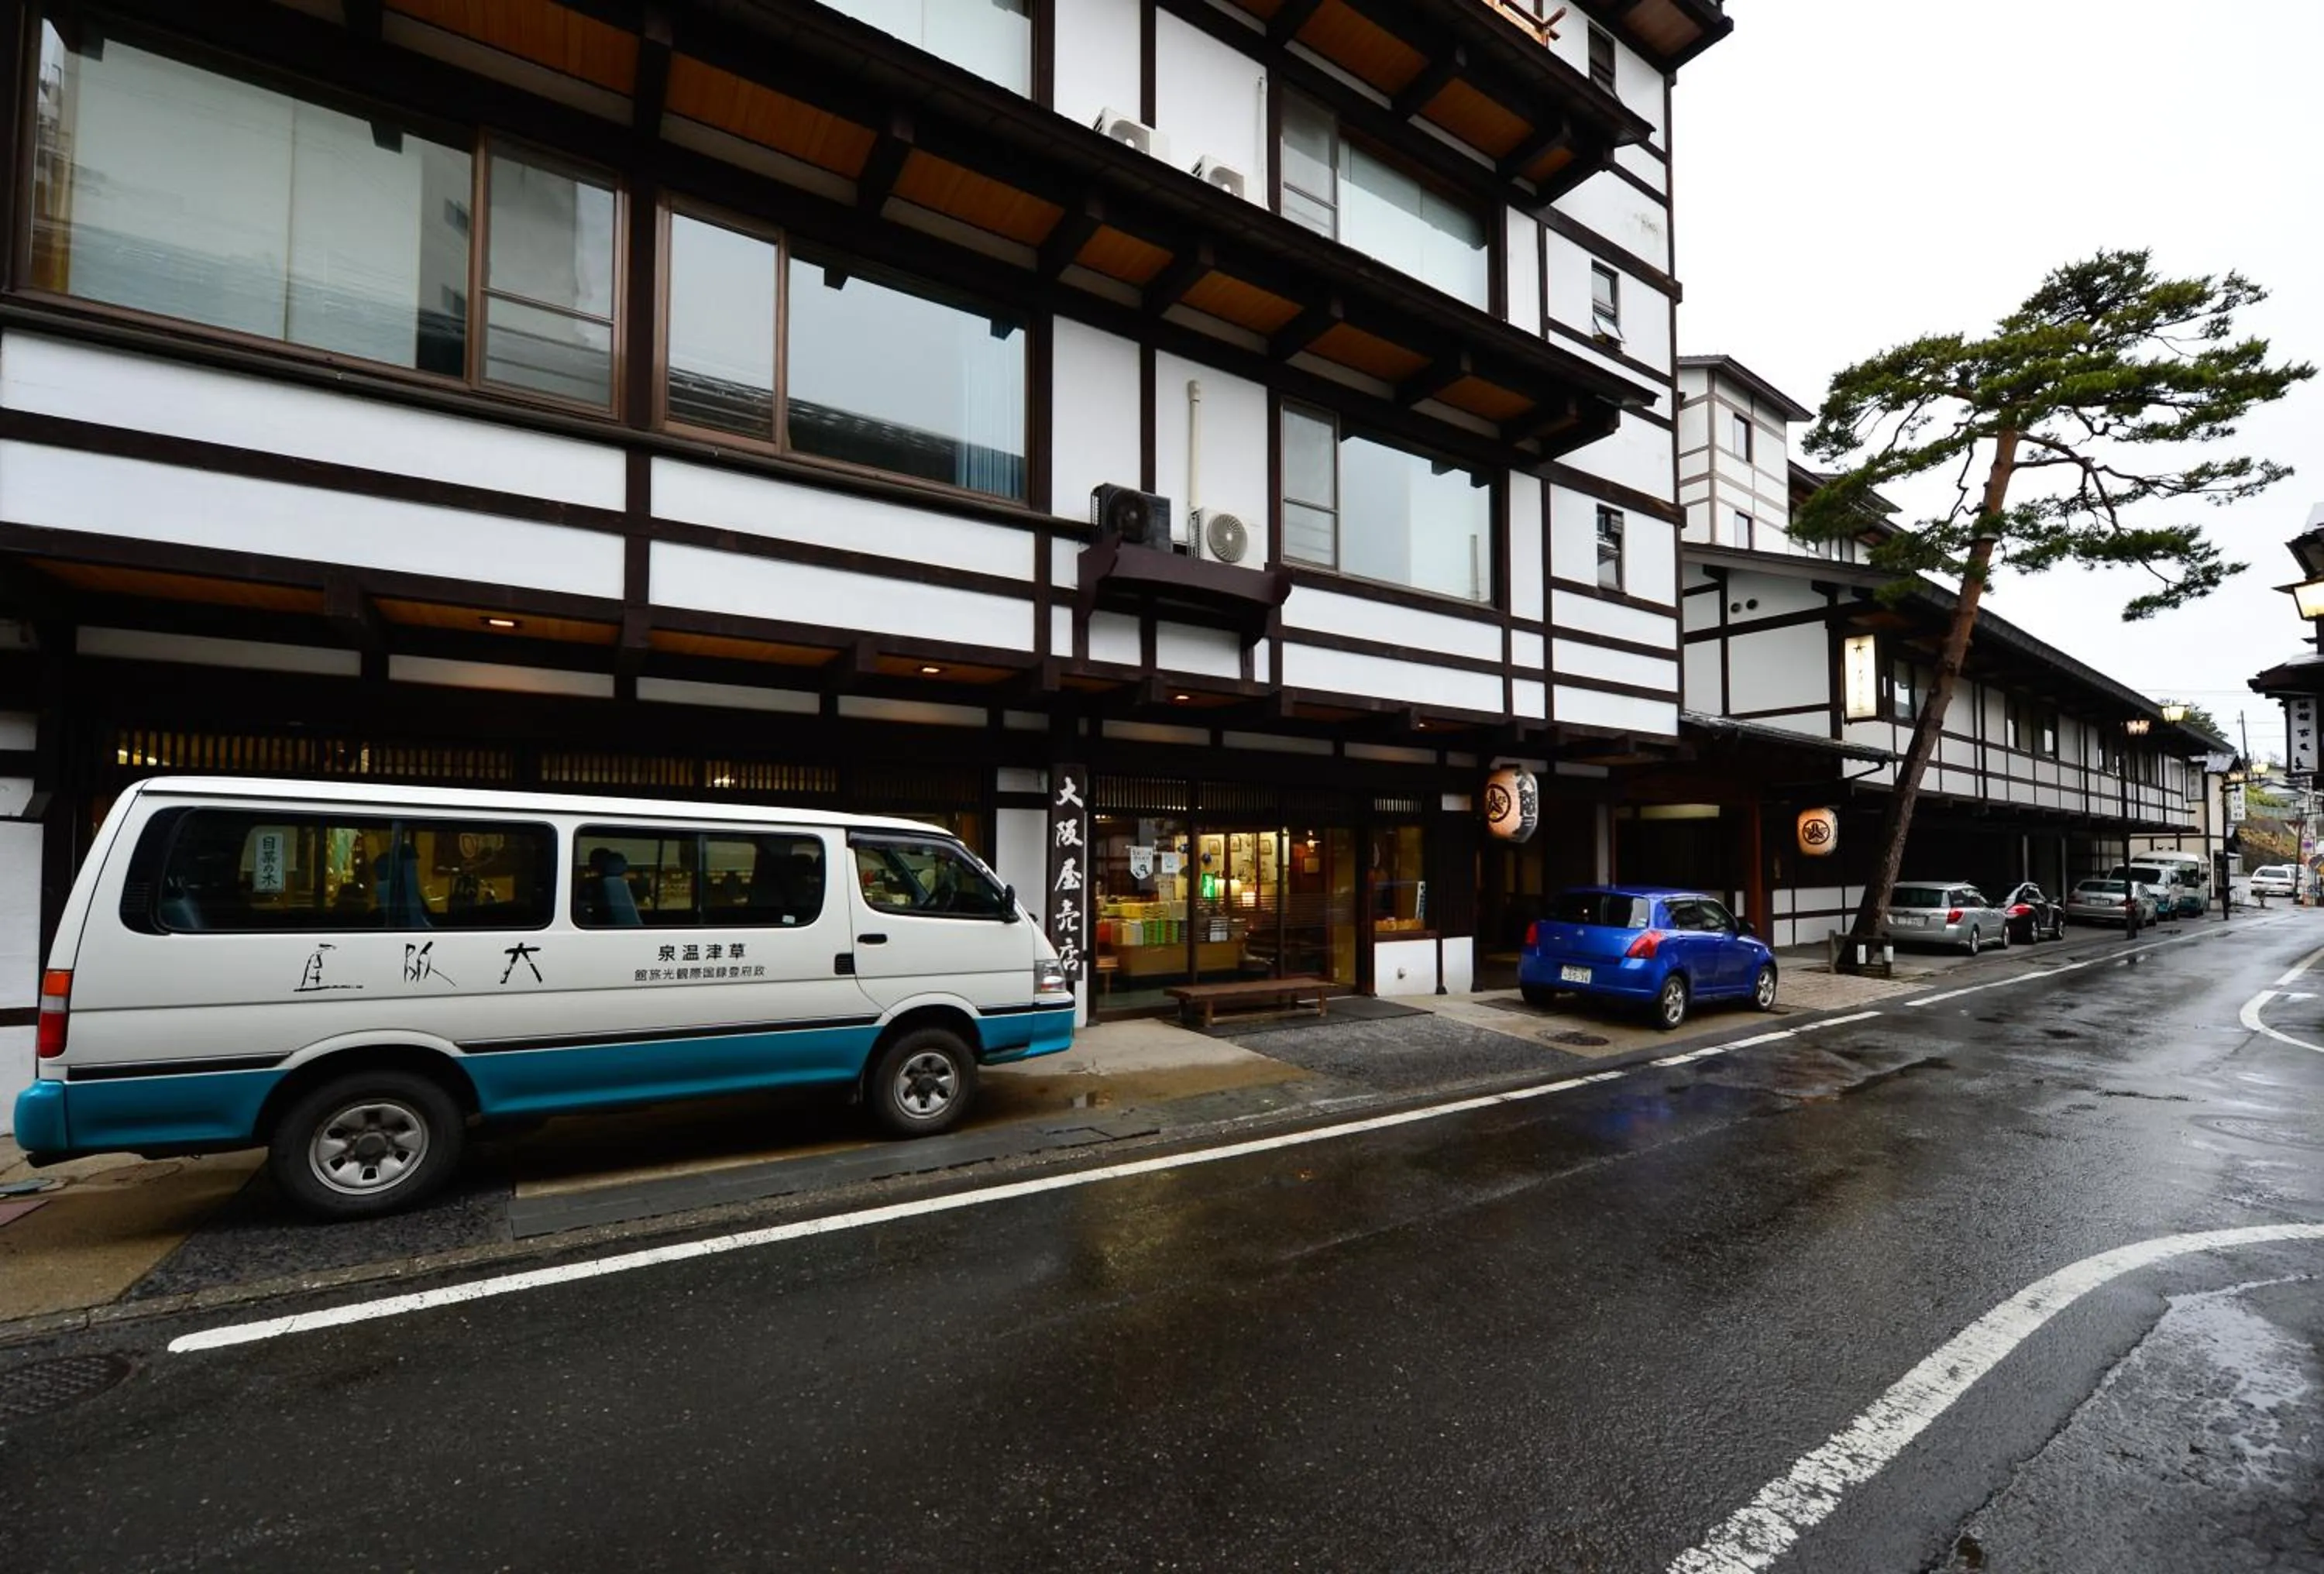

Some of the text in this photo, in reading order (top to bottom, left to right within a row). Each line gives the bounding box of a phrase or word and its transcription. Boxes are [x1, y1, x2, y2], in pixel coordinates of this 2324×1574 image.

[1054, 776, 1083, 971] 大阪屋売店
[658, 943, 745, 961] 草津温泉
